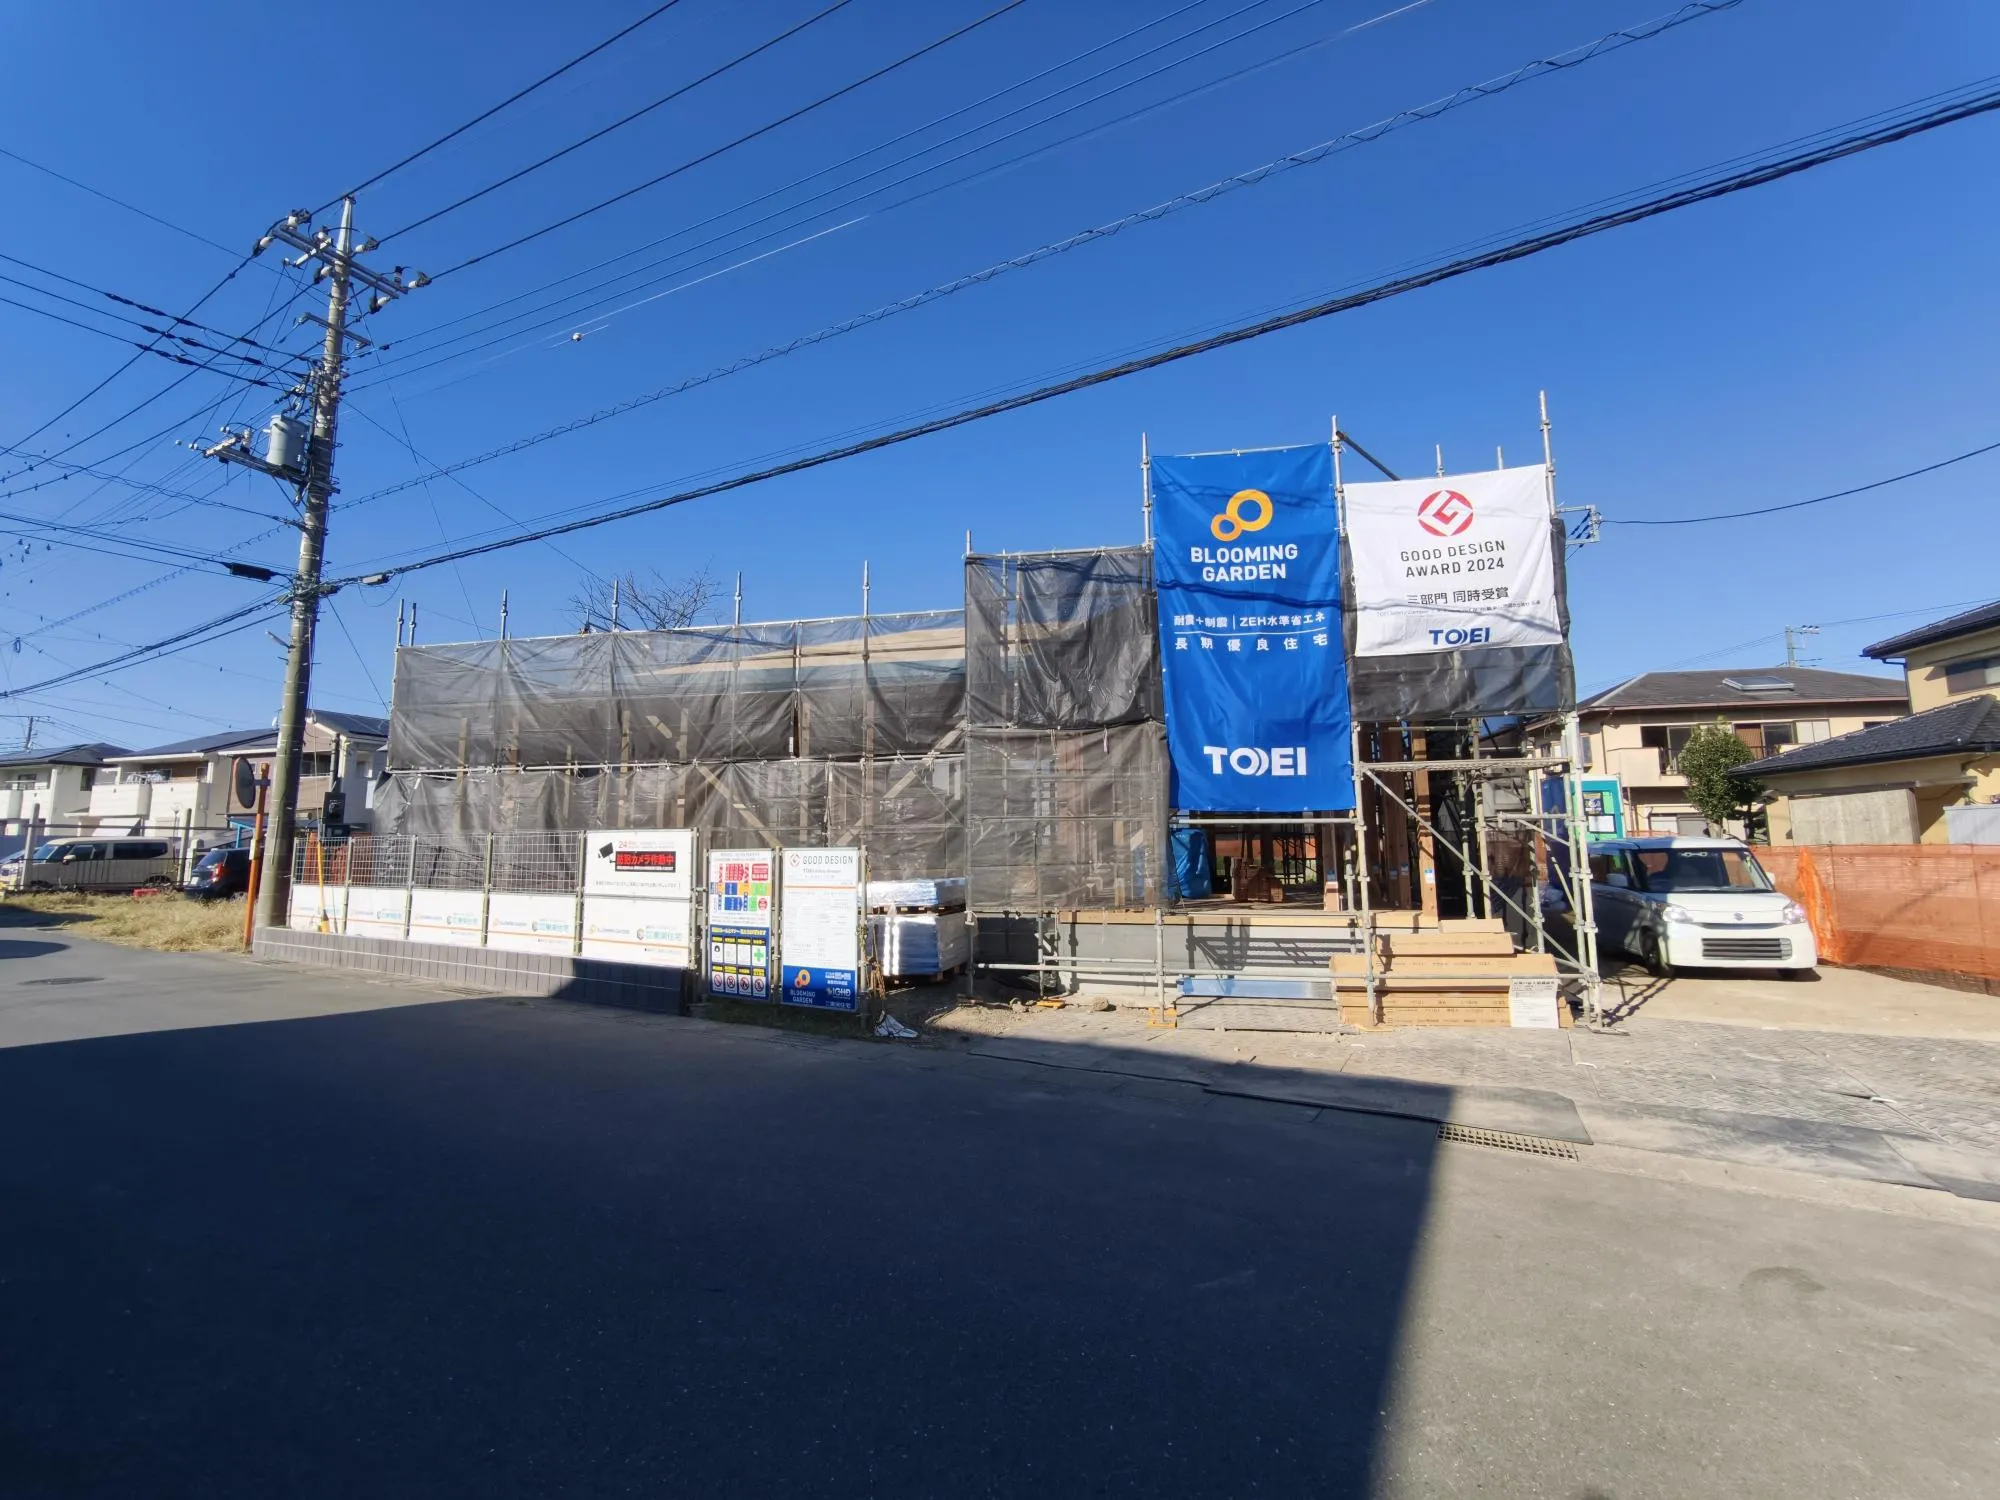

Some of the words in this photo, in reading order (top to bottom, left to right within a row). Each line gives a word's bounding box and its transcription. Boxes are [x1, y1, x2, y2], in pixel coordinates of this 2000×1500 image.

[1190, 543, 1299, 564] BLOOMING
[1400, 548, 1443, 563] GOOD
[1447, 539, 1506, 560] DESIGN
[1202, 563, 1287, 582] GARDEN
[1405, 559, 1462, 578] AWARD
[1467, 556, 1506, 573] 2024
[1406, 592, 1448, 606] 三部門
[1453, 586, 1509, 603] 同時受賞
